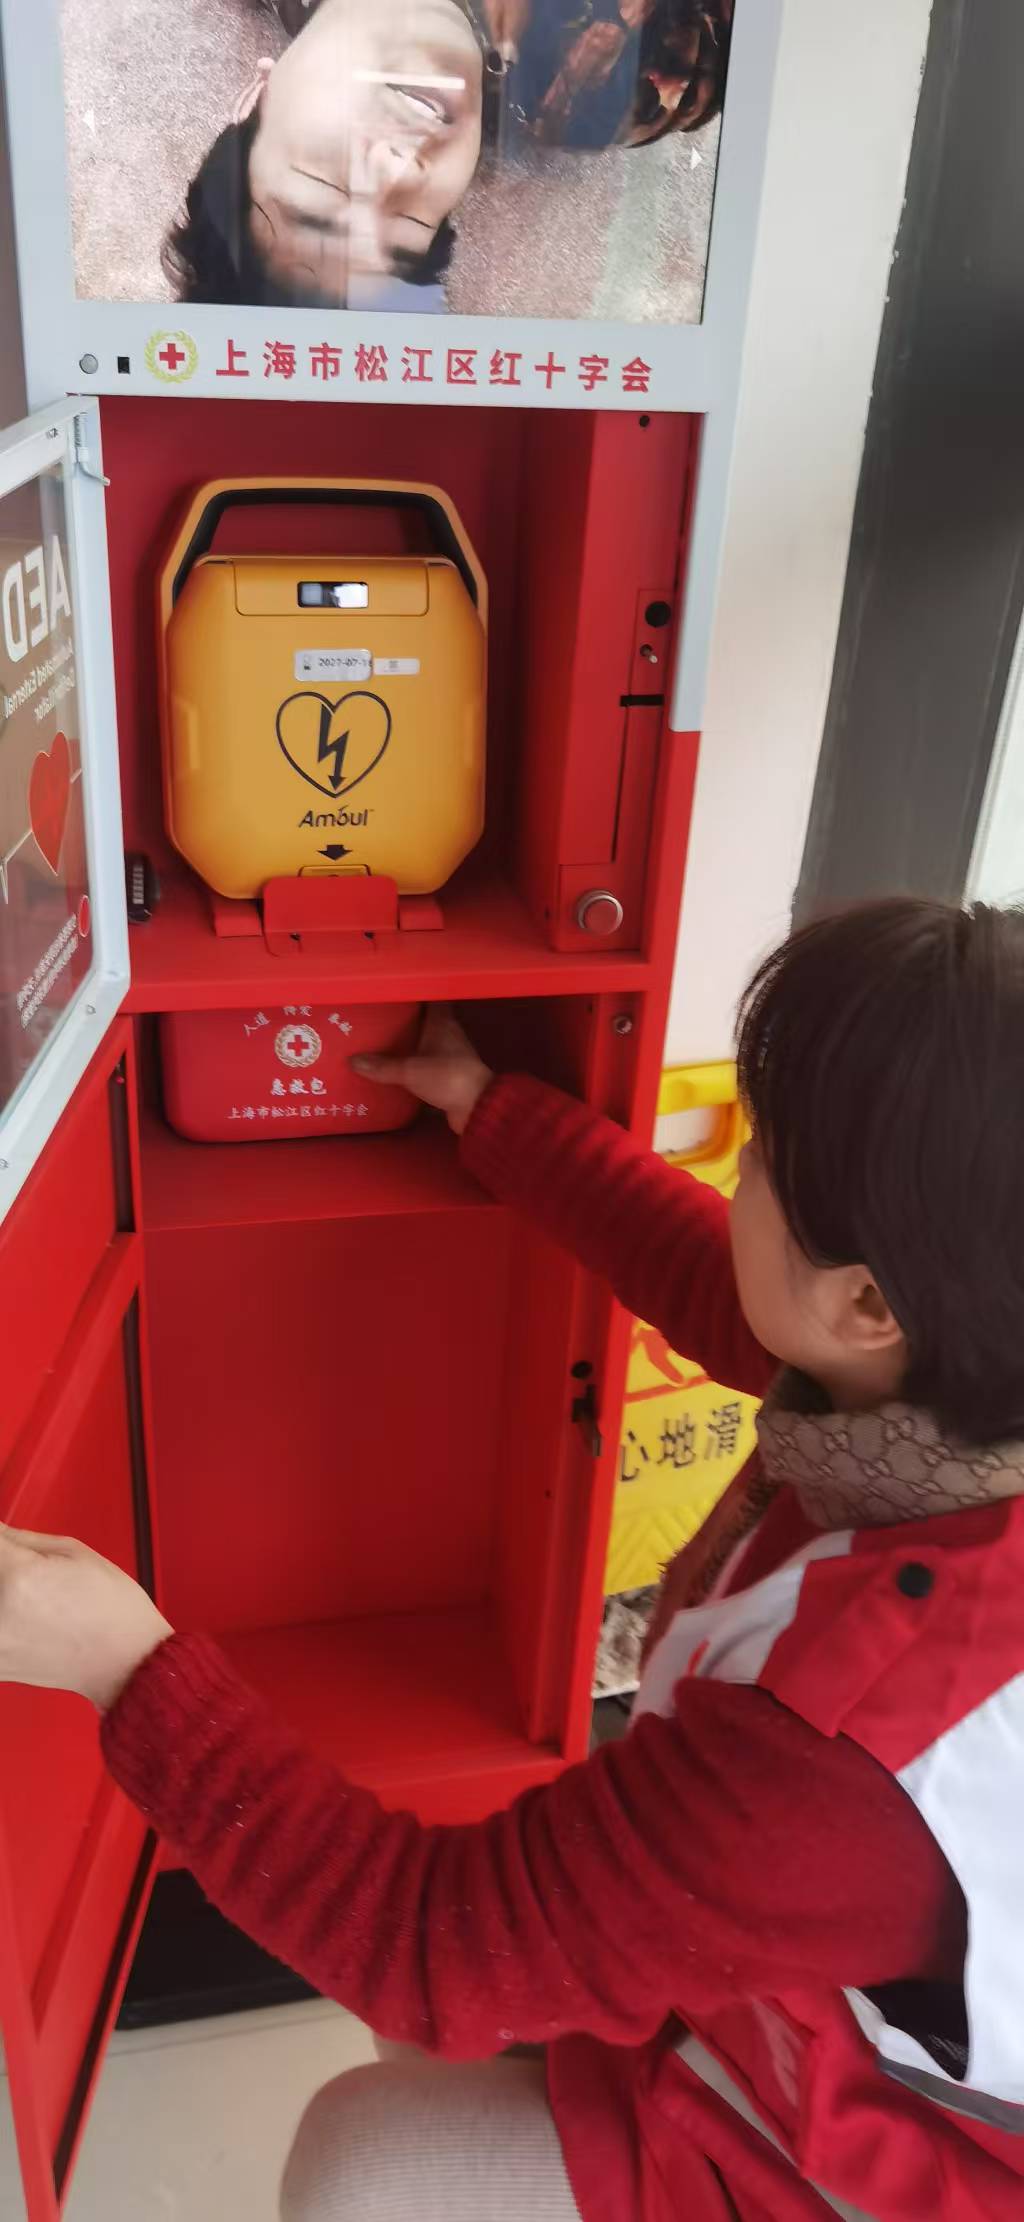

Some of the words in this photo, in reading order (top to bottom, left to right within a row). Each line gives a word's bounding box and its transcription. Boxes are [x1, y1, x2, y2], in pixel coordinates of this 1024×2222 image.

[215, 339, 654, 393] 上海市松江区红十字会
[269, 1077, 327, 1096] 急救包
[227, 1103, 370, 1120] 上海市松江区红十字会
